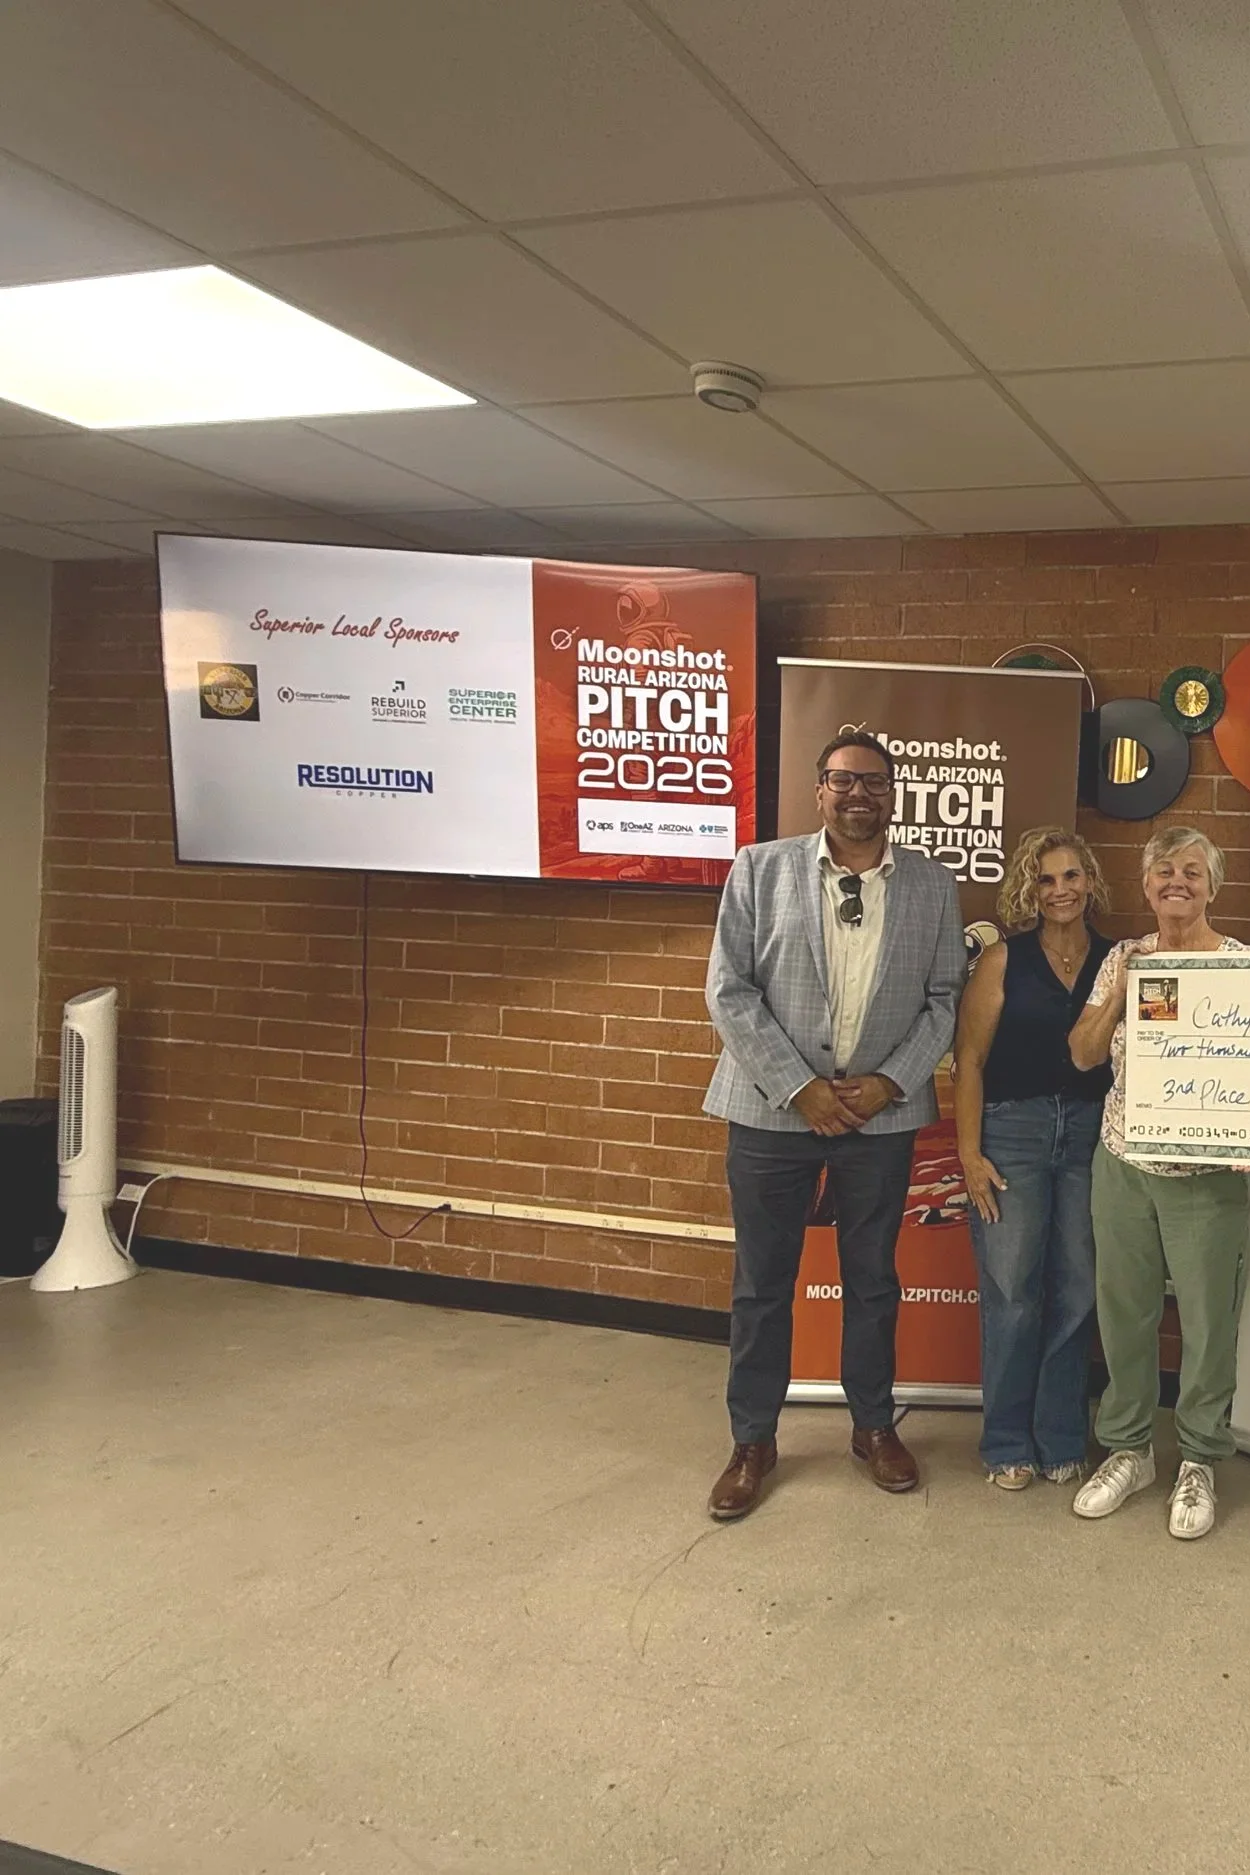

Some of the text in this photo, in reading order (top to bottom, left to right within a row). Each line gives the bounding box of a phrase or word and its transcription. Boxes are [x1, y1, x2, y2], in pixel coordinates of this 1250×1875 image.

[250, 609, 460, 648] Superior Local Sponsors
[578, 666, 728, 691] RURAL ARIZONA
[371, 697, 426, 709] REBUILD
[449, 689, 516, 700] SUPERIOR
[449, 698, 517, 707] ENTERPRISE
[371, 708, 426, 719] SUPERIOR
[450, 705, 517, 718] CENTER
[577, 684, 728, 734] PITCH
[577, 728, 727, 755] COMPETITION
[297, 764, 433, 793] RESOLUTION
[577, 752, 733, 795] 2026
[926, 766, 1004, 784] ARIZONA
[336, 790, 397, 798] COPPER
[891, 782, 1004, 827] ITCH
[597, 822, 613, 831] aps
[628, 822, 653, 830] OneAZ
[658, 824, 693, 832] ARIZONA
[886, 825, 1002, 848] MPETITION
[1154, 1036, 1194, 1060] Two
[1163, 1079, 1250, 1109] 3rd Place
